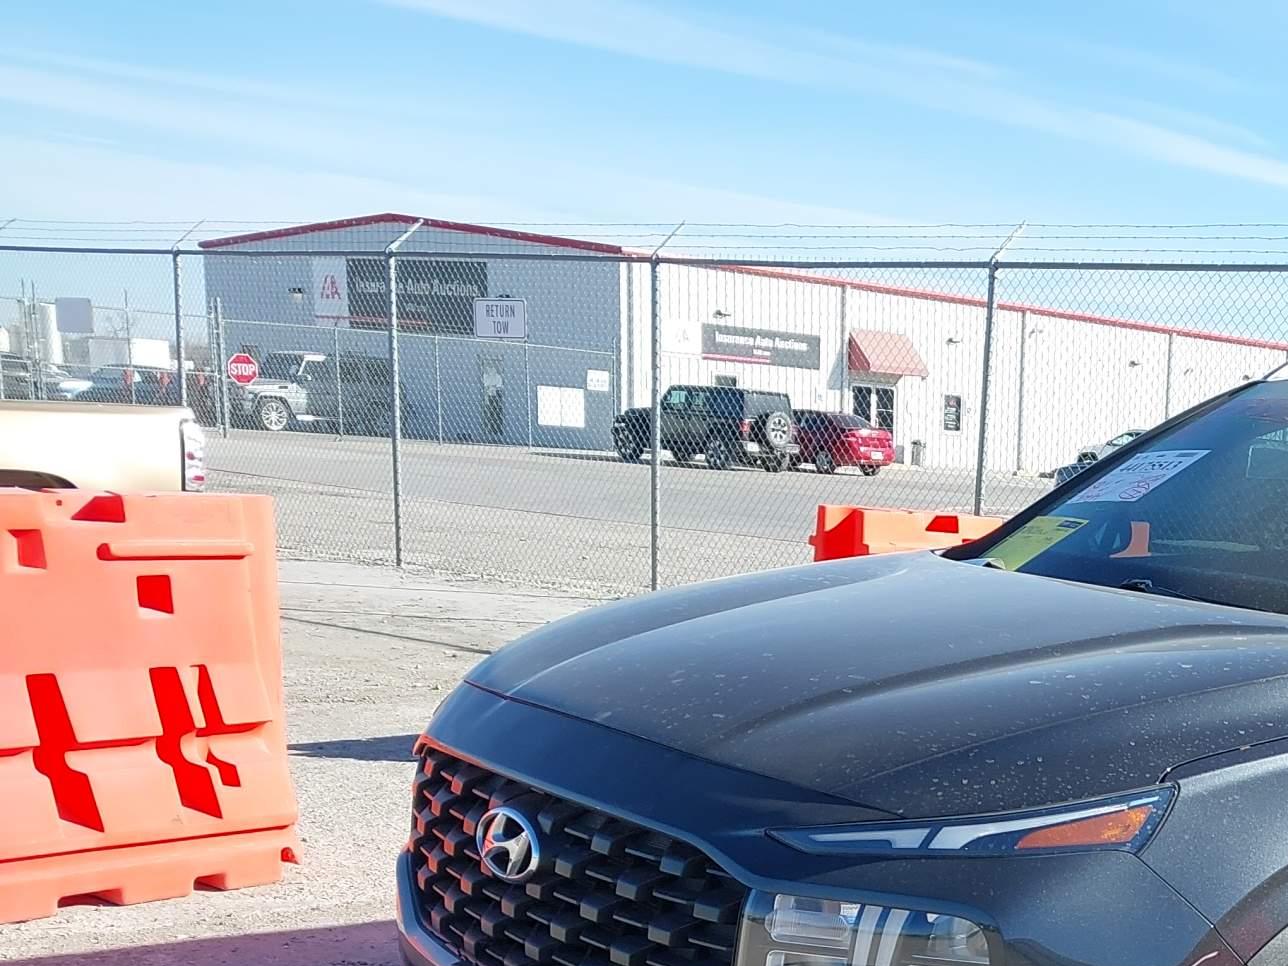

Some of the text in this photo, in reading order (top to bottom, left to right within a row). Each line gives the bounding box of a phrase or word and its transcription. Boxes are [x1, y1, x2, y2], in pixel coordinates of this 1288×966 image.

[355, 277, 404, 294] Insurae
[485, 304, 516, 319] RETURN
[493, 320, 509, 335] TOW
[230, 362, 256, 376] STOP
